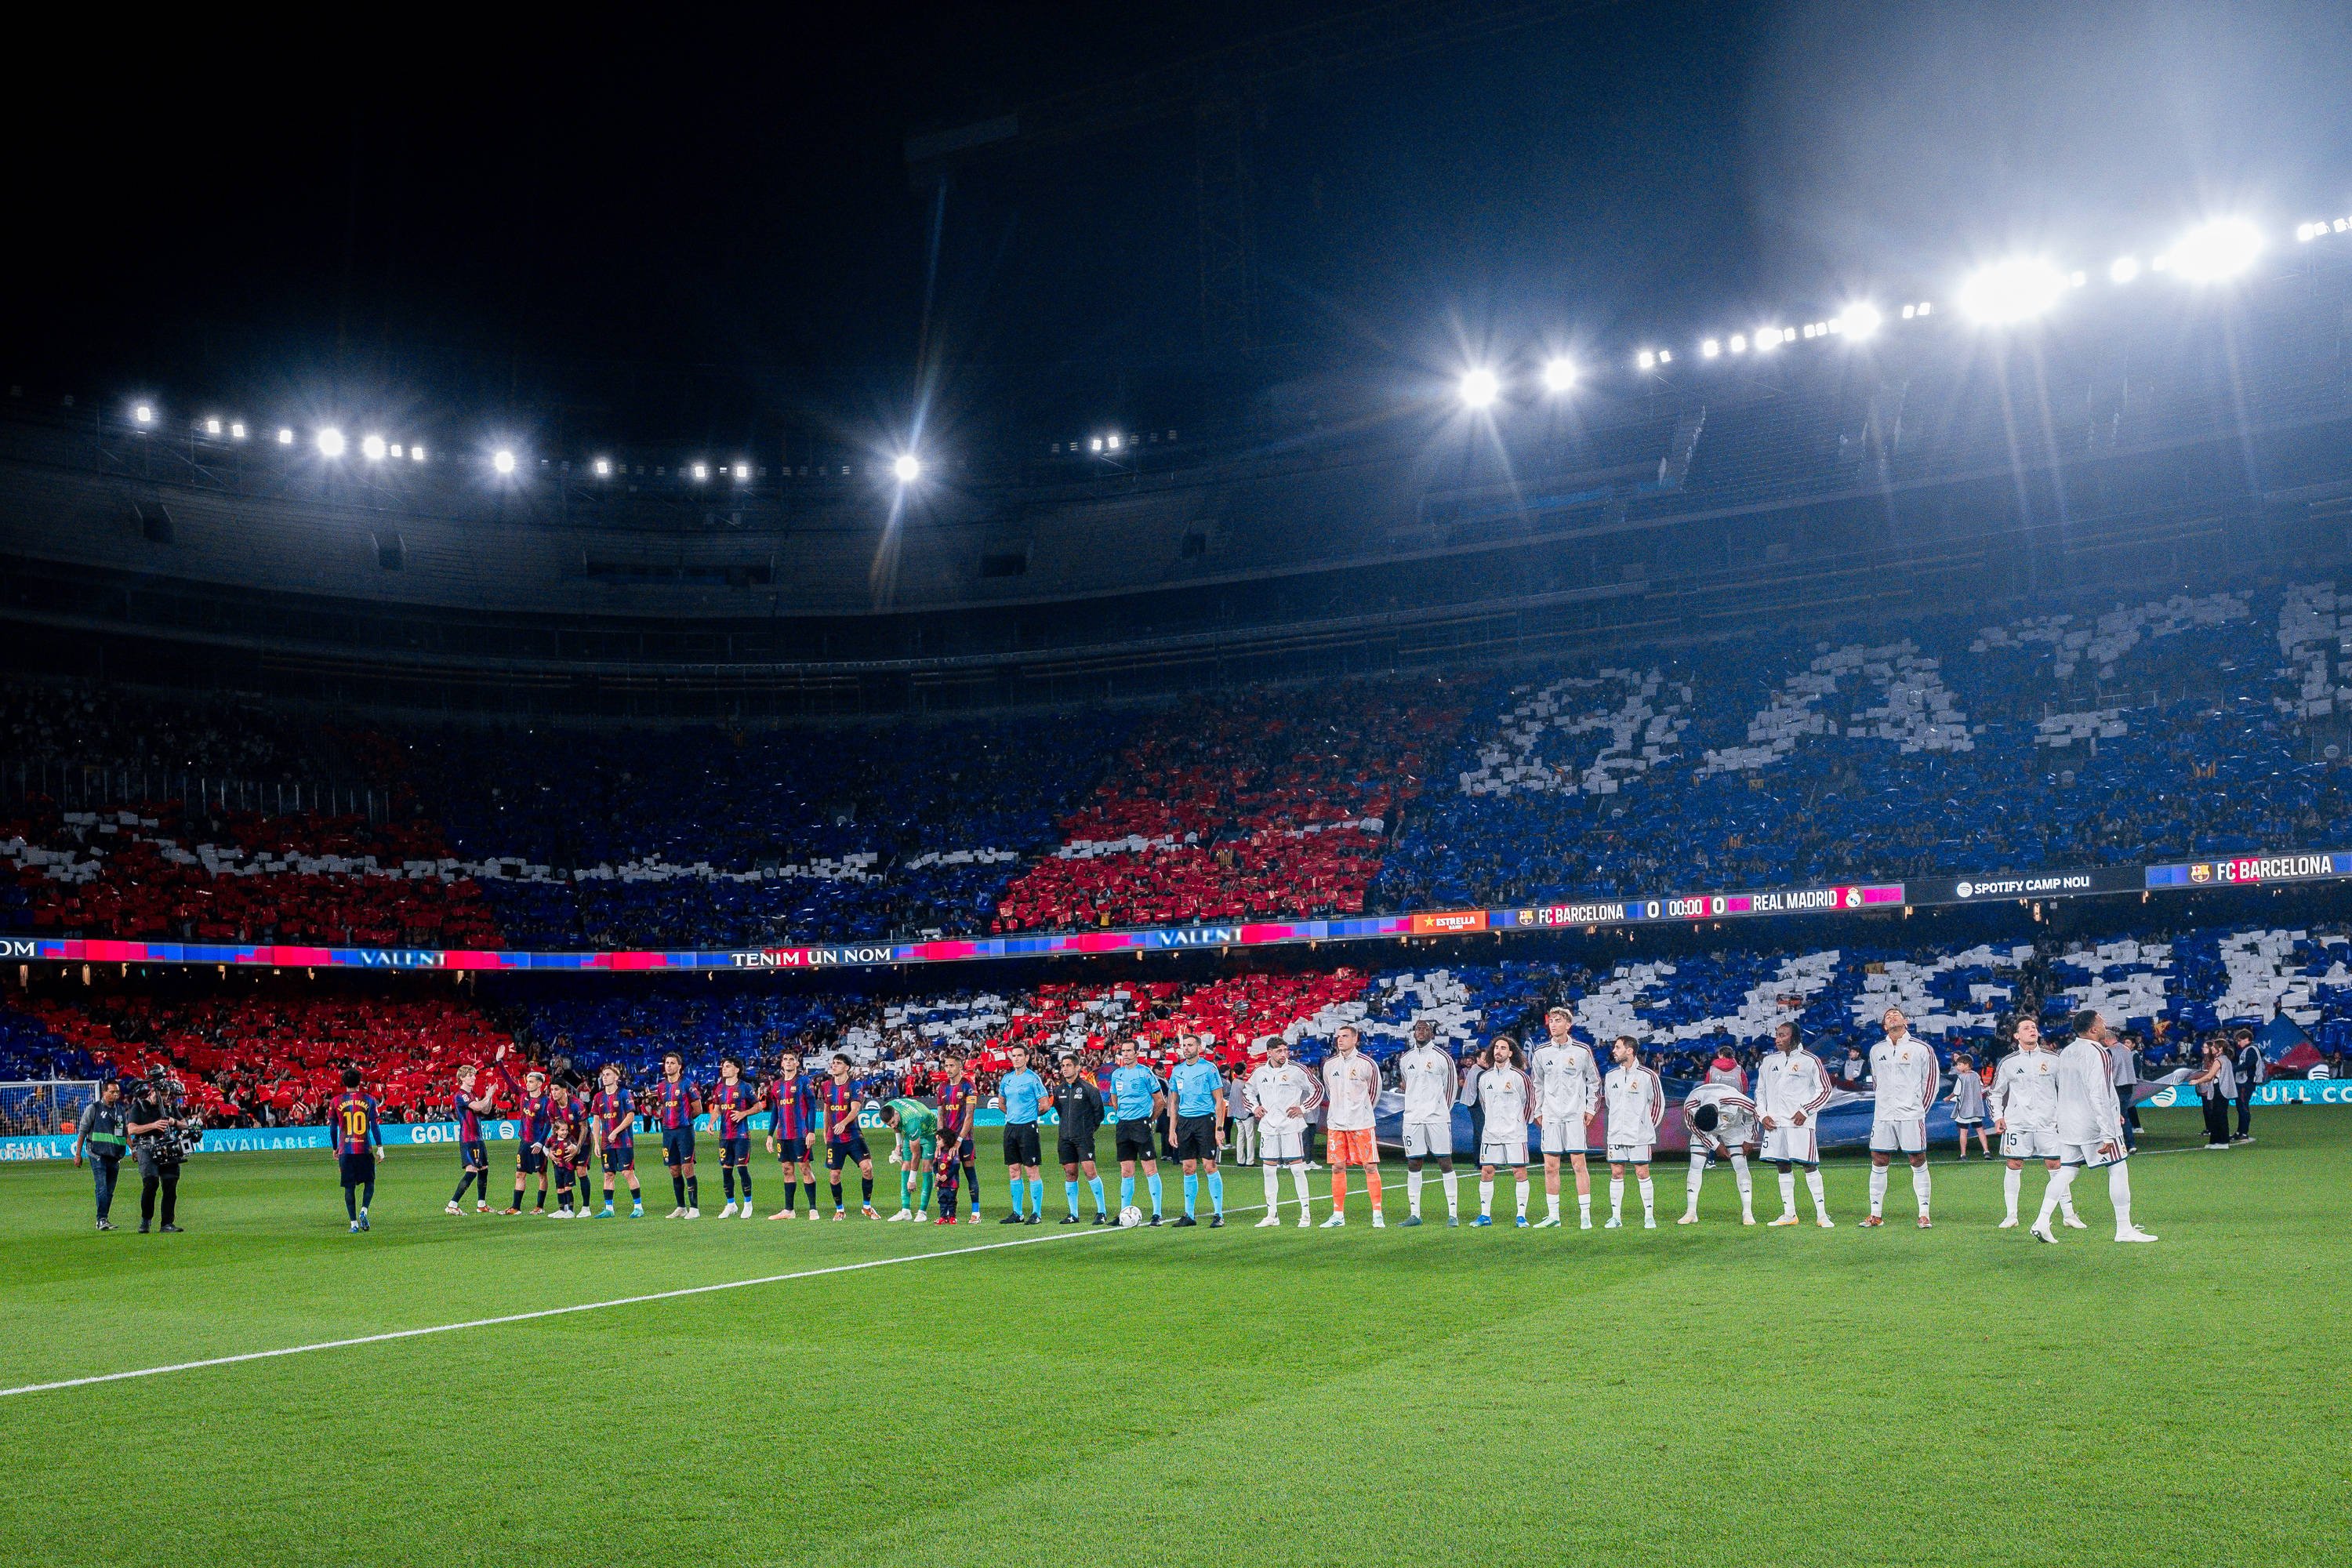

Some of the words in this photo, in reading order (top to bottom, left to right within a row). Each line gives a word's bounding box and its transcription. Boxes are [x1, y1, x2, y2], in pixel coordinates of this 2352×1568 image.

[2217, 862, 2237, 880] FC
[2239, 855, 2332, 879] BARCELONA
[1974, 880, 2024, 895] SPOTIFY
[2027, 877, 2062, 891] CAMP
[2063, 877, 2090, 888] NOU
[1538, 908, 1553, 924] FC
[1555, 904, 1624, 924] BARCELONA
[1647, 901, 1660, 918] 0
[1668, 898, 1703, 916] 00:00
[1711, 897, 1725, 914] 0
[1753, 894, 1784, 911] REAL
[1787, 890, 1838, 909] MADRID
[1436, 916, 1475, 927] ESTRELLA
[731, 952, 800, 967] TENIM
[807, 949, 837, 964] UN
[844, 948, 891, 963] NOM
[2251, 1086, 2312, 1102] ULL
[343, 1111, 366, 1135] 10
[213, 1136, 317, 1152] AVAILABLE
[1403, 1135, 1412, 1147] 16
[2005, 1133, 2017, 1146] 15
[827, 1148, 833, 1159] 5
[1481, 1142, 1489, 1155] 17
[602, 1153, 608, 1163] 7
